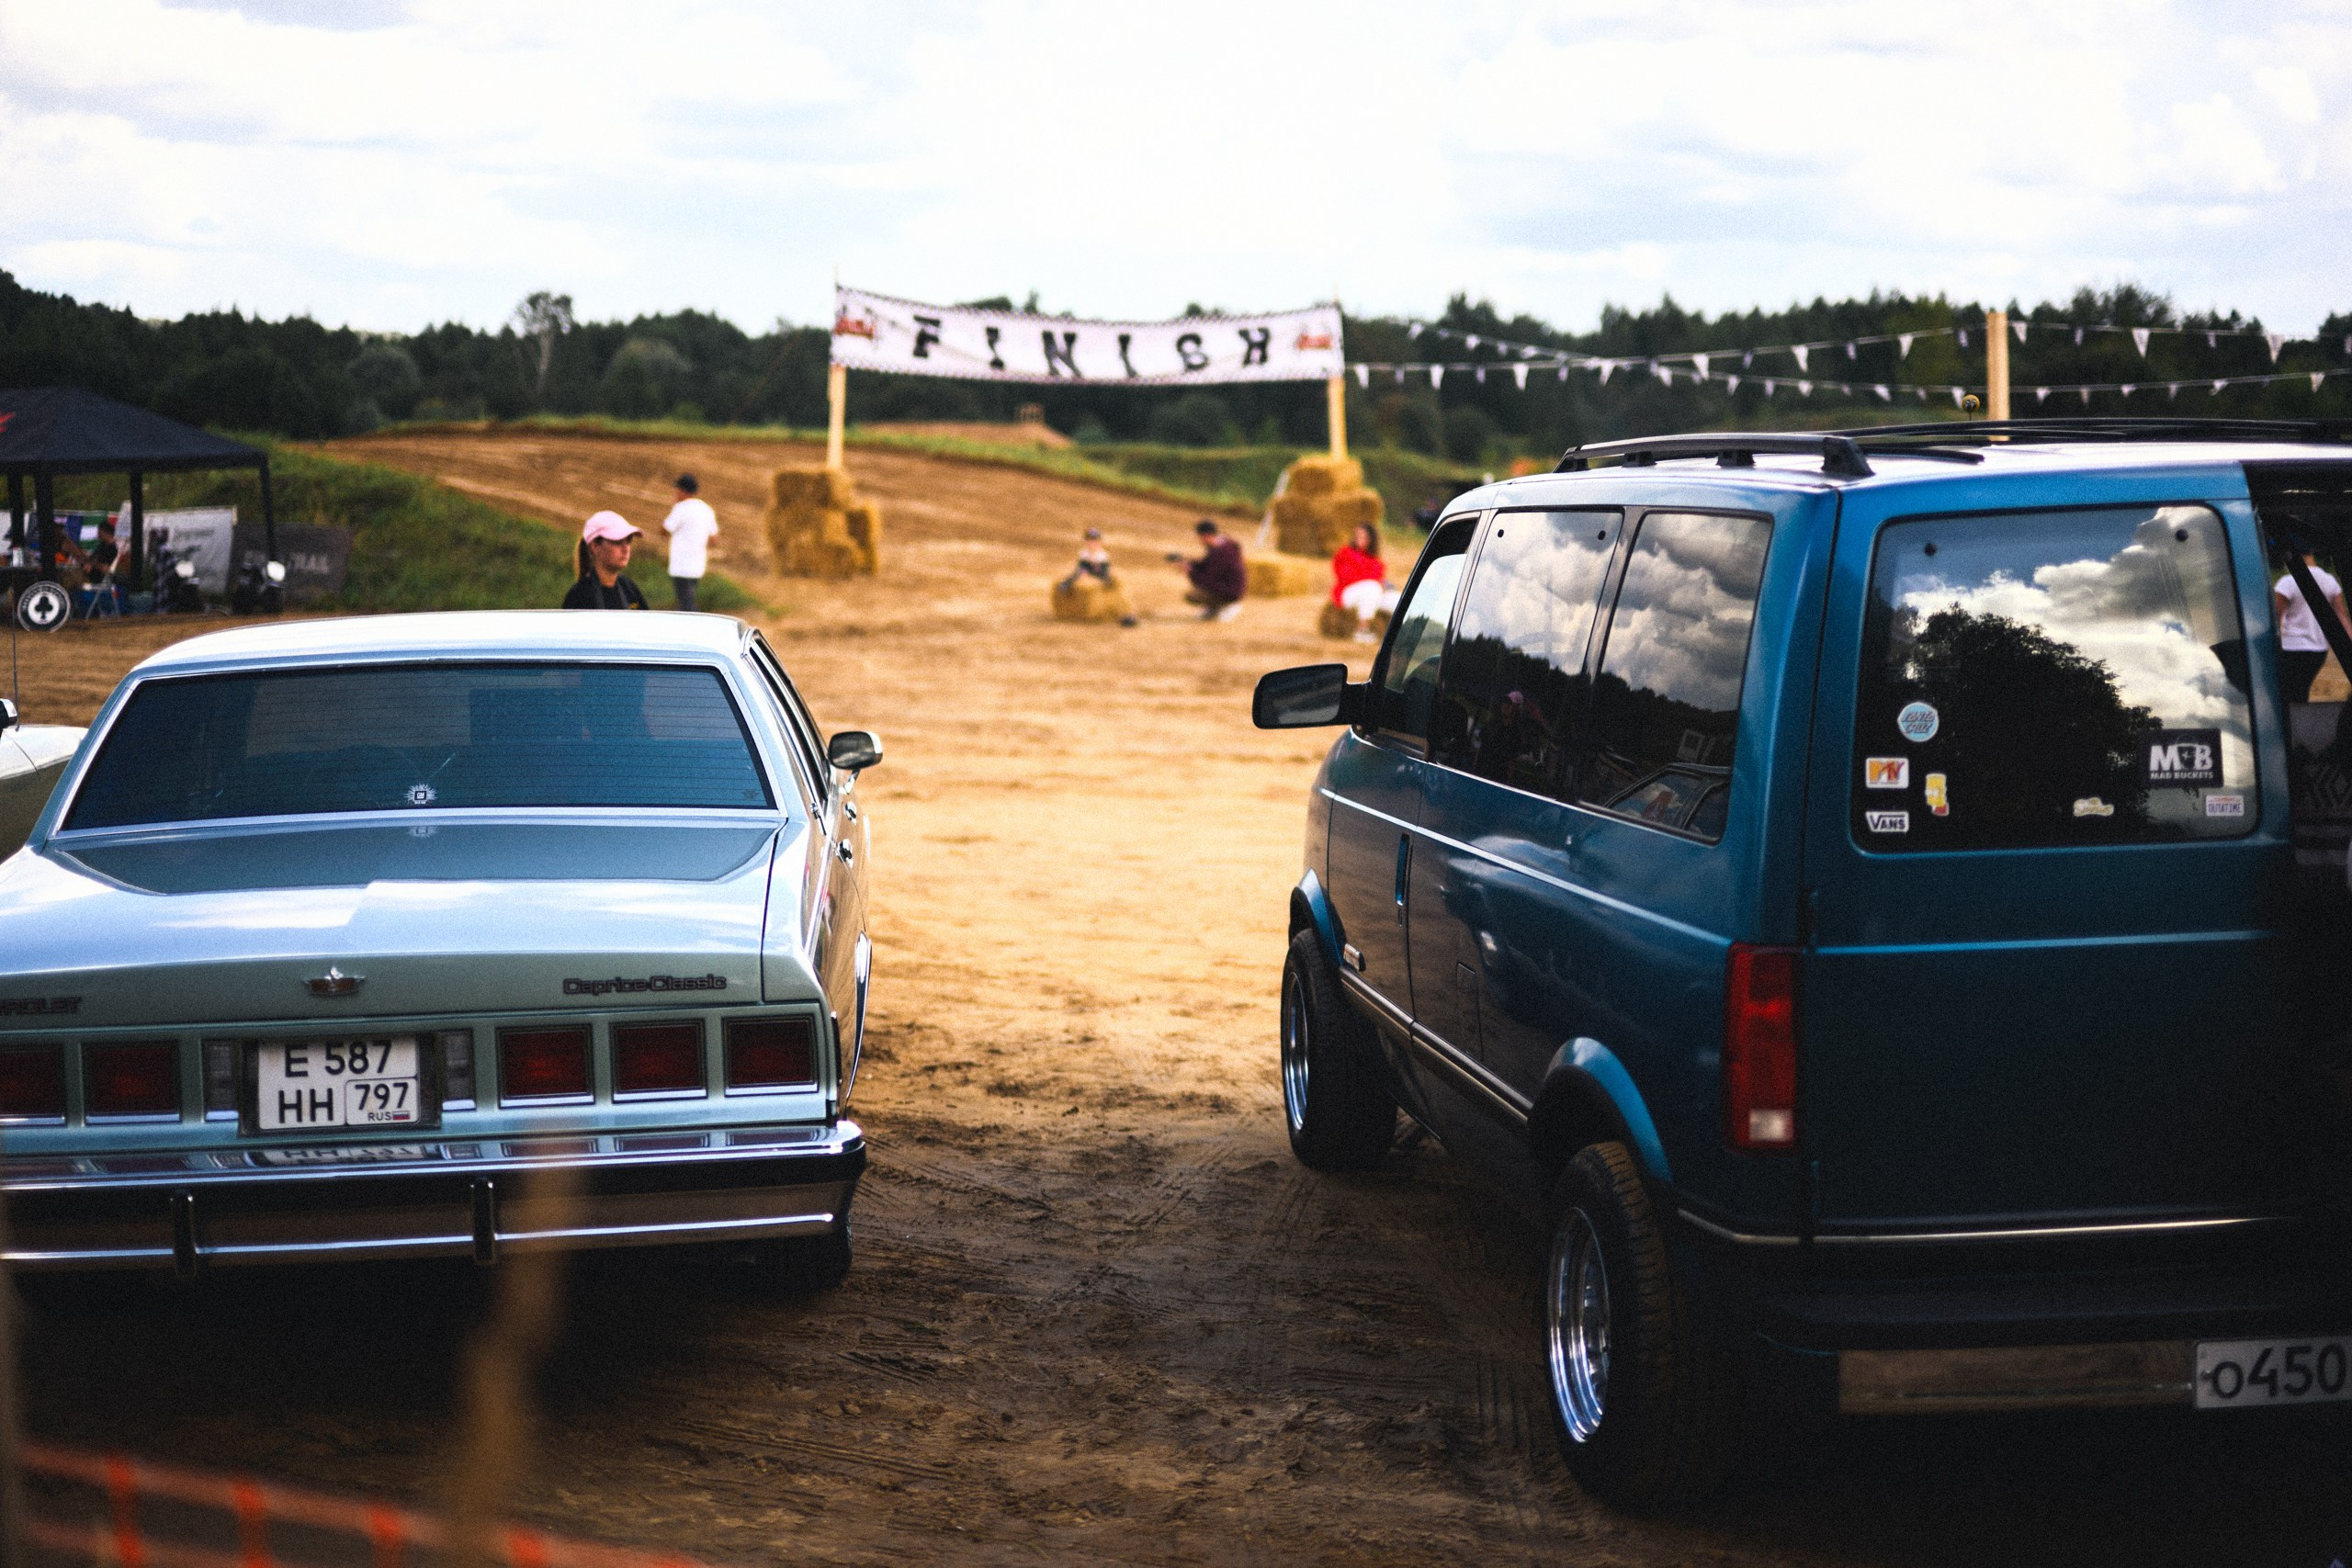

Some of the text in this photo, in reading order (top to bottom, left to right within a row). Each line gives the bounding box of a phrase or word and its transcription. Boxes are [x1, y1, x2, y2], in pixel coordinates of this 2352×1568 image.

[912, 315, 1270, 378] FINISH
[1869, 760, 1906, 784] MTV
[2150, 771, 2214, 780] MAD BUCKETS
[563, 974, 727, 997] Caprice Classic
[285, 1039, 392, 1077] E 587
[278, 1081, 409, 1123] HH 797
[368, 1111, 391, 1122] RUS
